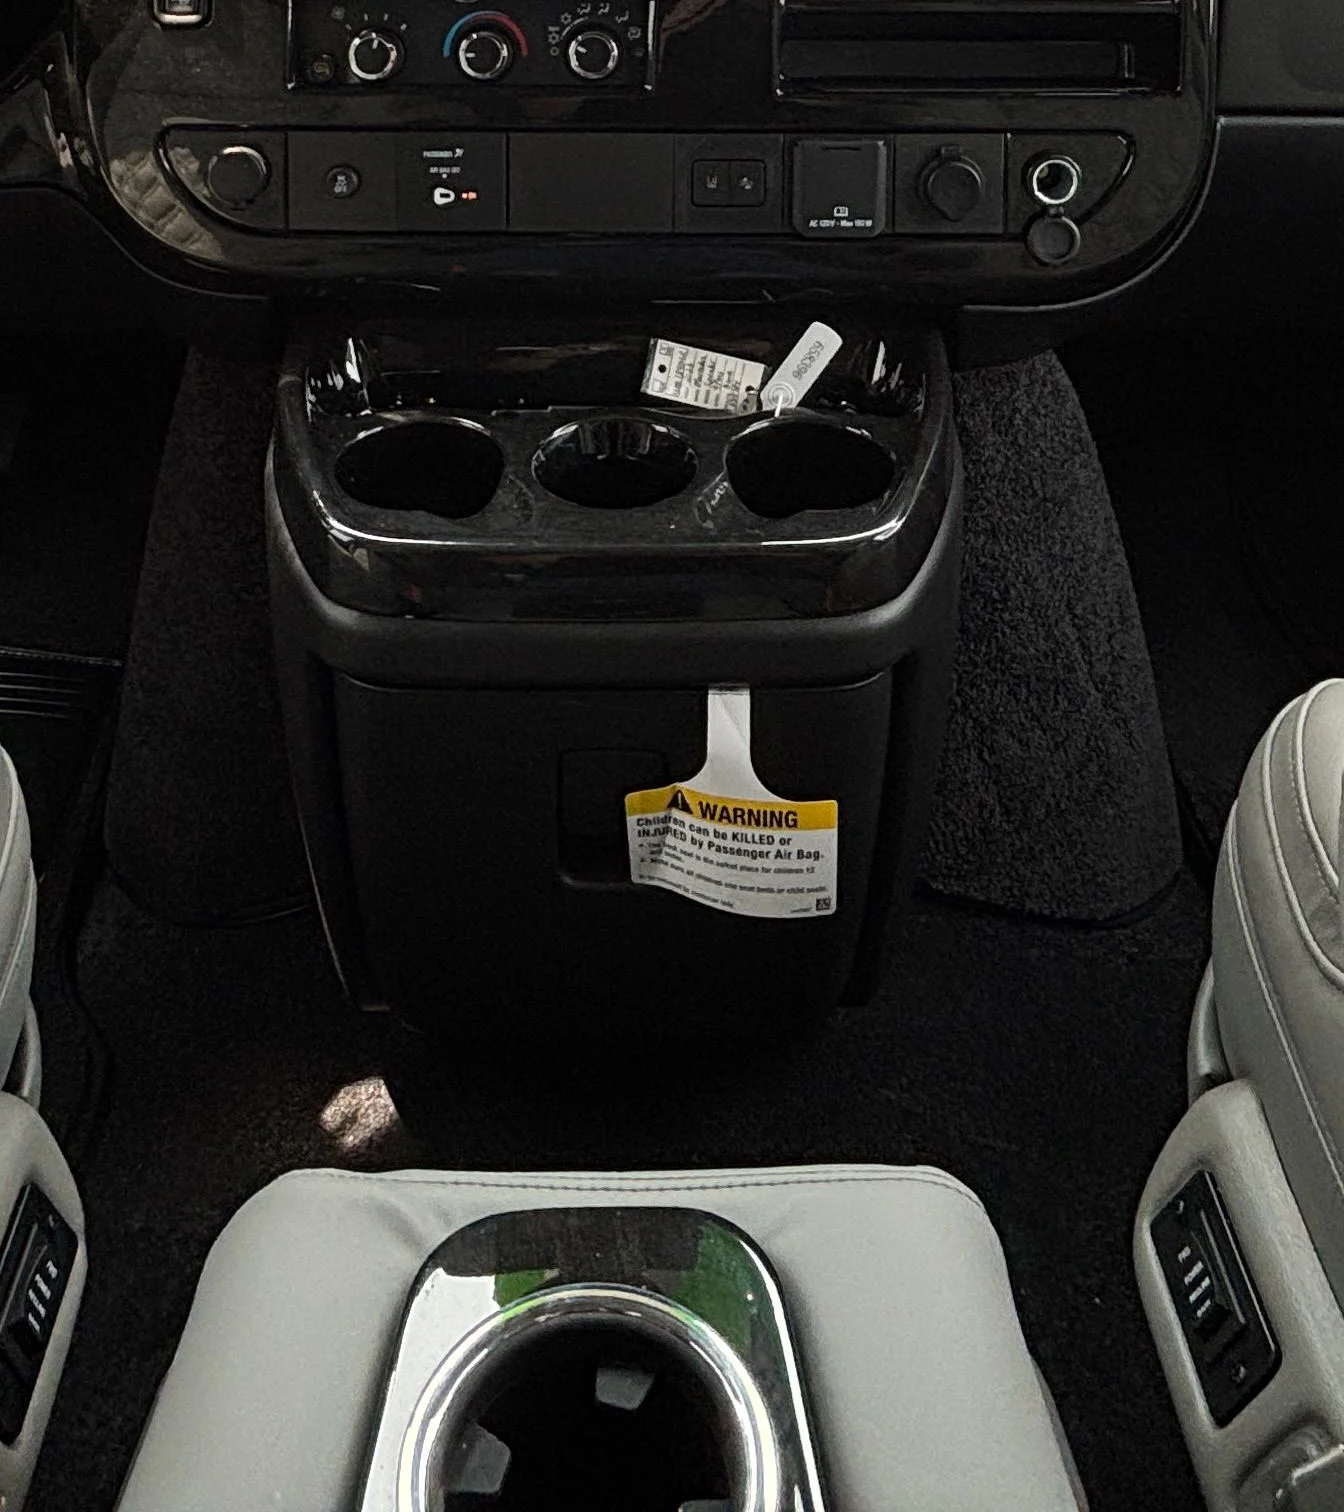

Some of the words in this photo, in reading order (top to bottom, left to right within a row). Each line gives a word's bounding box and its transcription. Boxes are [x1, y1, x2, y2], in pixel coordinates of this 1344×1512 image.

[636, 815, 686, 828] Children
[688, 822, 710, 837] can
[713, 828, 728, 841] be
[731, 831, 775, 846] KILLED
[779, 837, 793, 846] or
[698, 801, 799, 830] WARNING
[637, 826, 687, 842] INJURED
[690, 834, 704, 849] by
[707, 840, 772, 860] Passenger
[774, 849, 793, 860] Air
[796, 849, 824, 861] Bag.
